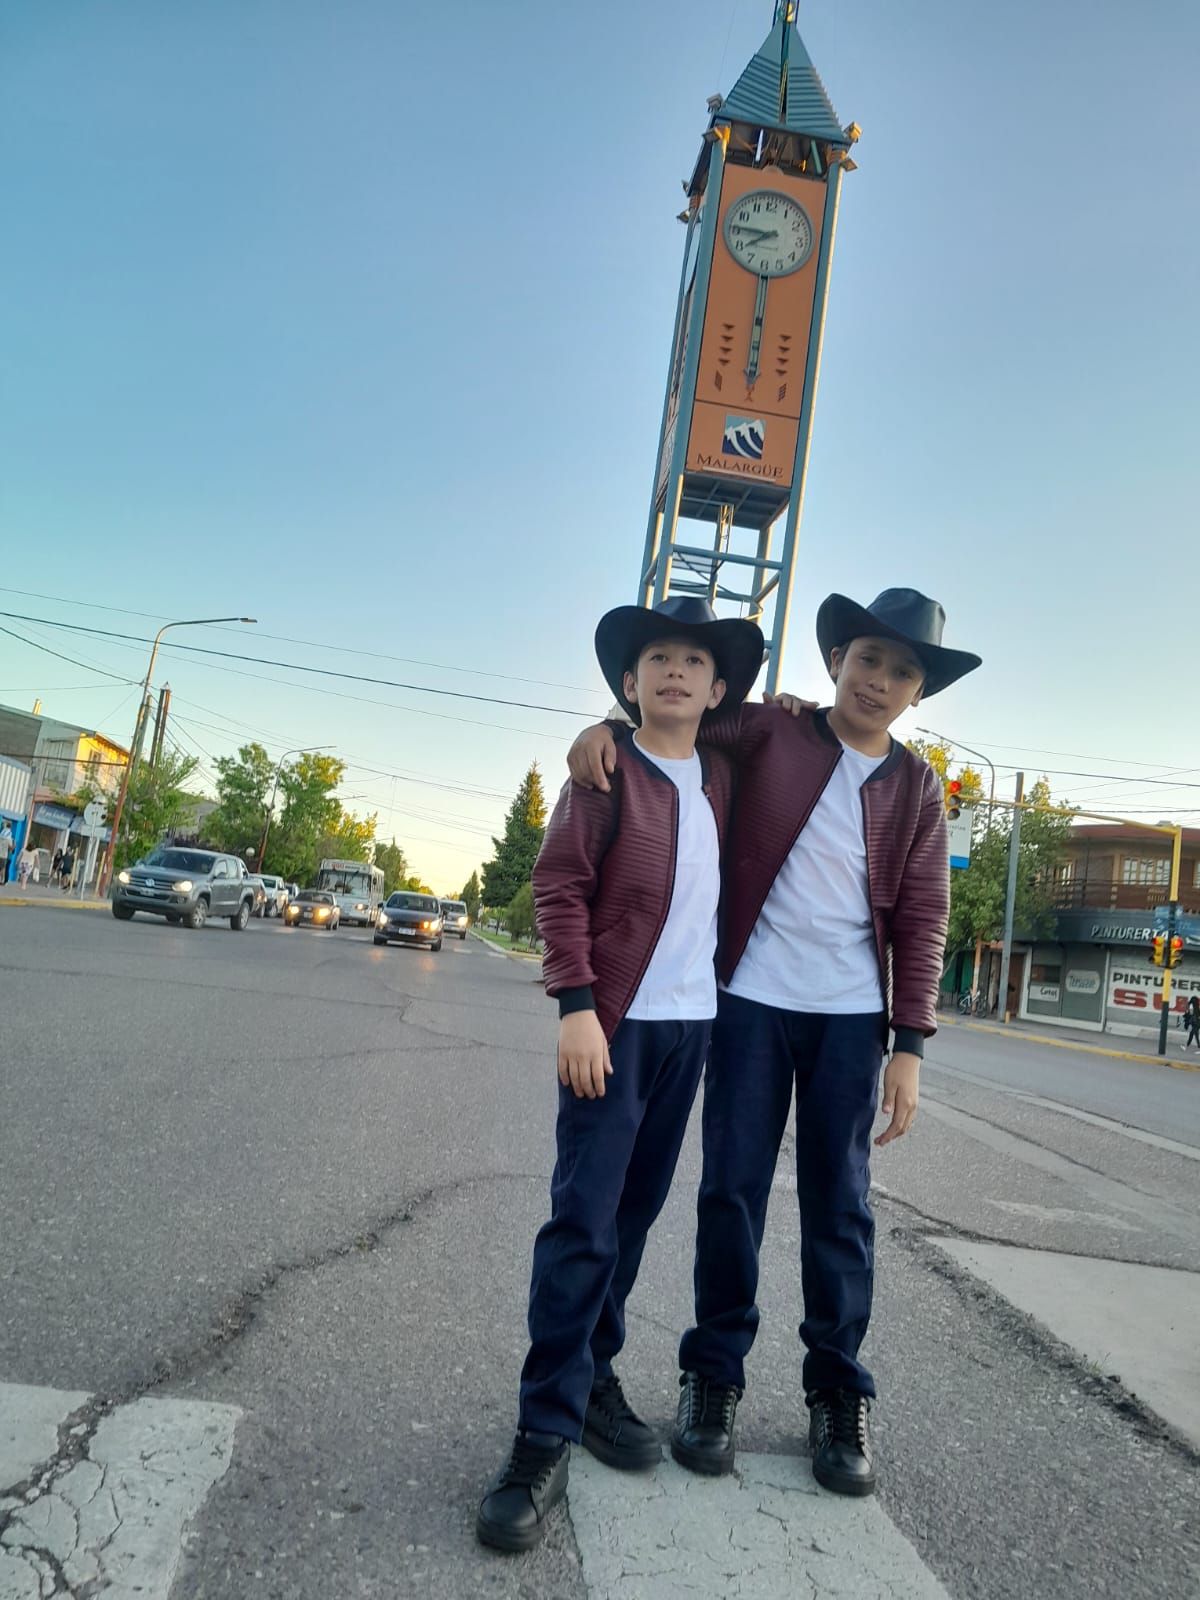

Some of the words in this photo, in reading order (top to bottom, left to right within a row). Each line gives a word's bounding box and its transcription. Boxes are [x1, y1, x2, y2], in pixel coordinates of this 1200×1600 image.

[753, 202, 760, 213] 11
[766, 201, 777, 213] 12
[739, 211, 750, 222] 10
[784, 209, 788, 219] 1
[792, 221, 801, 232] 2
[735, 240, 744, 251] 8
[795, 237, 804, 248] 3
[747, 252, 756, 264] 7
[788, 251, 795, 262] 4
[760, 260, 769, 271] 6
[775, 259, 784, 271] 5
